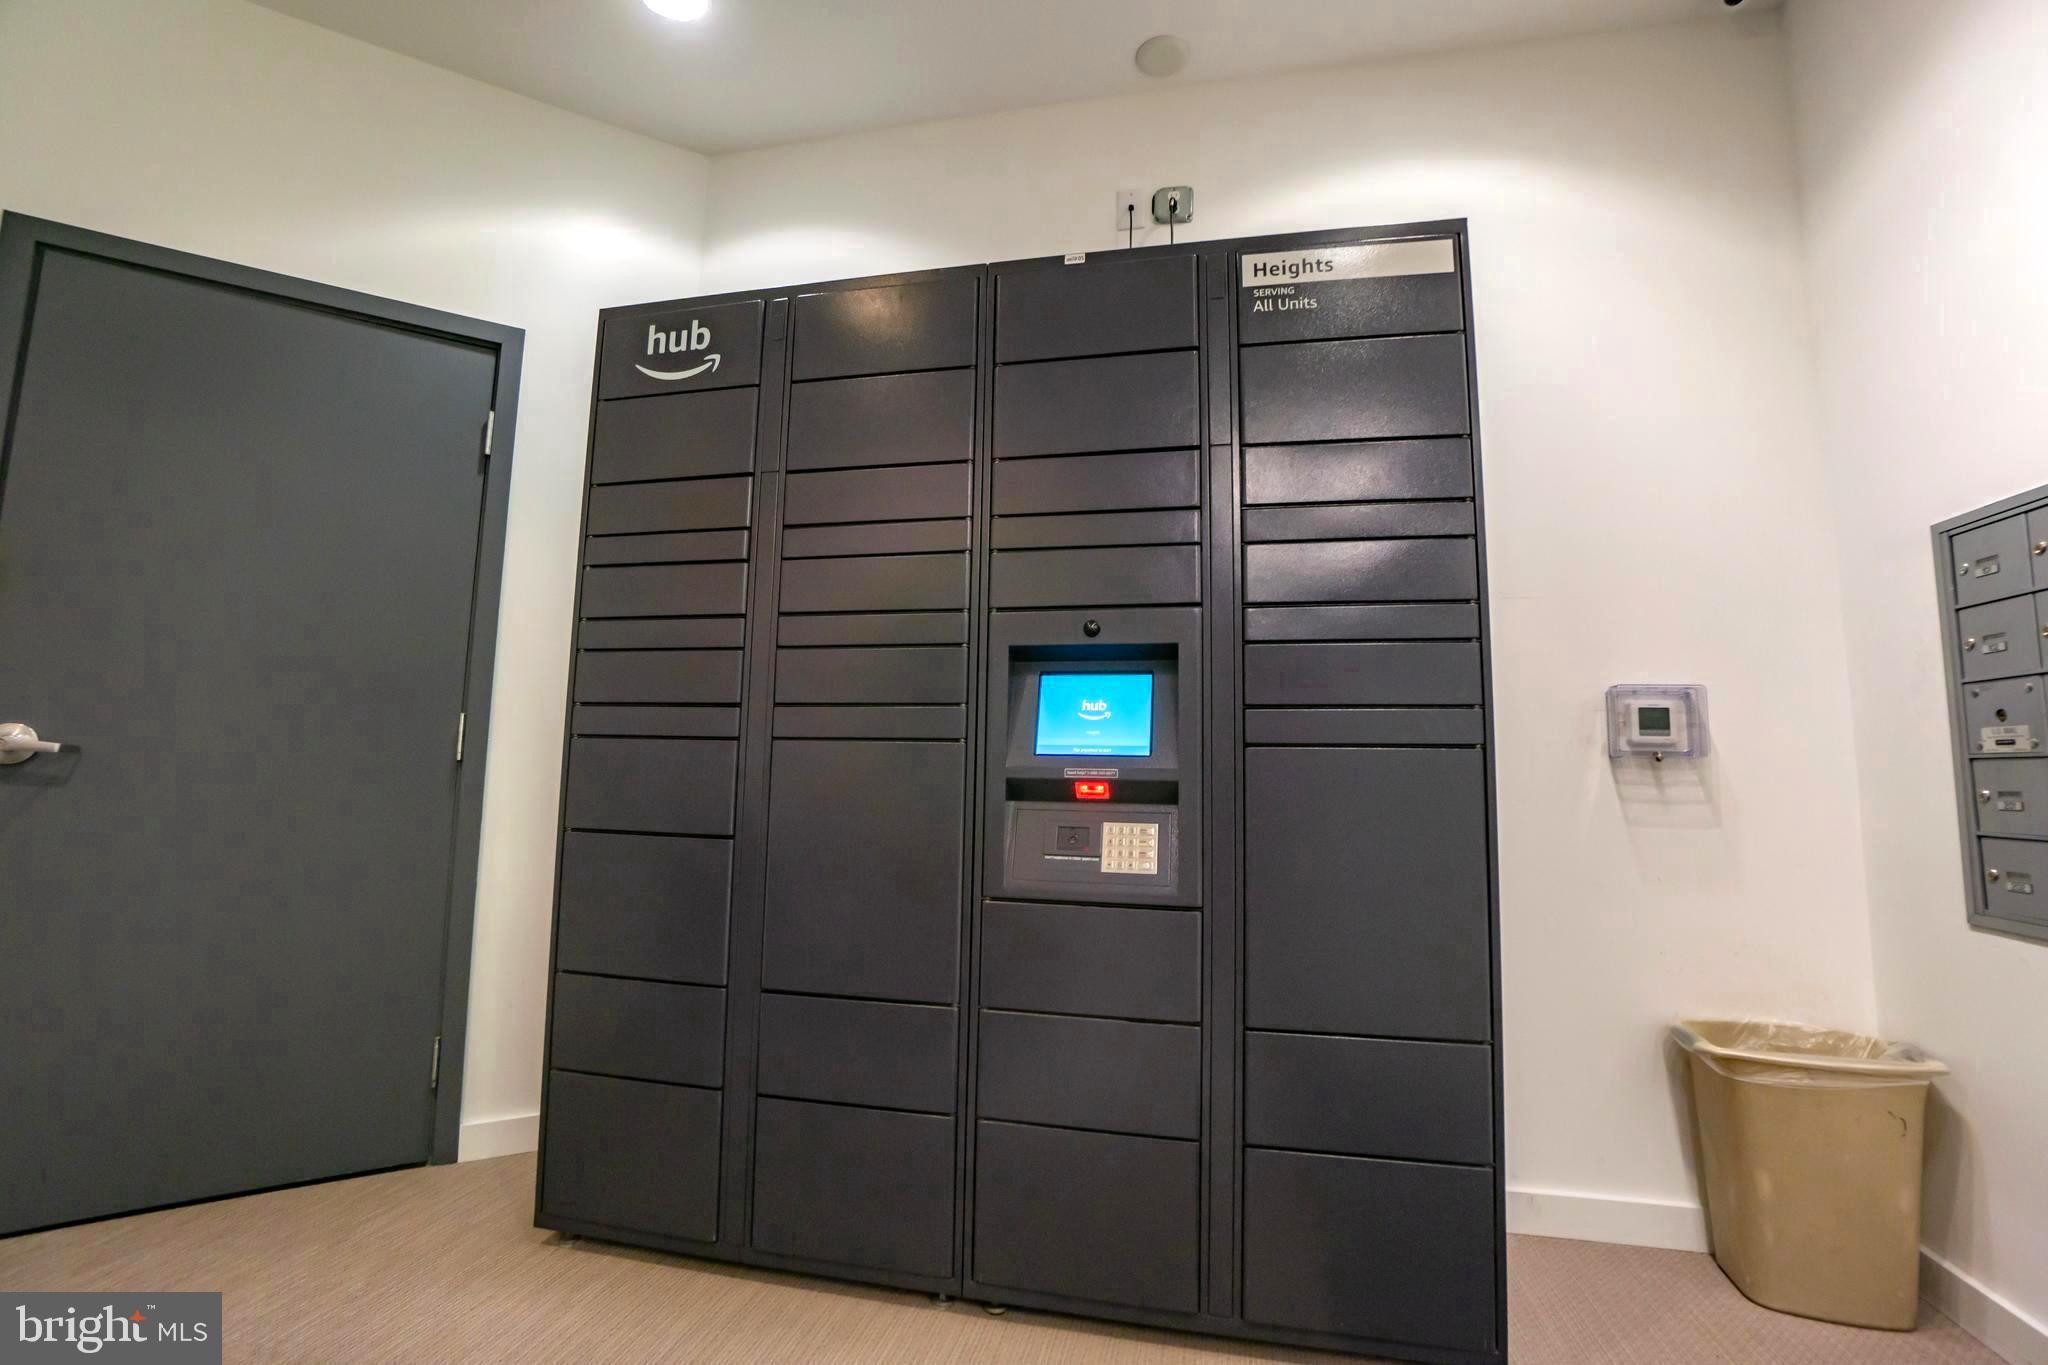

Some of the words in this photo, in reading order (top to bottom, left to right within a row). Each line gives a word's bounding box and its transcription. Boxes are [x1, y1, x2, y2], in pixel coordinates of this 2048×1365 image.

[1253, 258, 1334, 279] Heights
[1253, 286, 1295, 298] SERVING
[1253, 298, 1273, 312] All
[1278, 295, 1318, 311] Units
[647, 319, 711, 355] hub
[1081, 699, 1107, 711] hub
